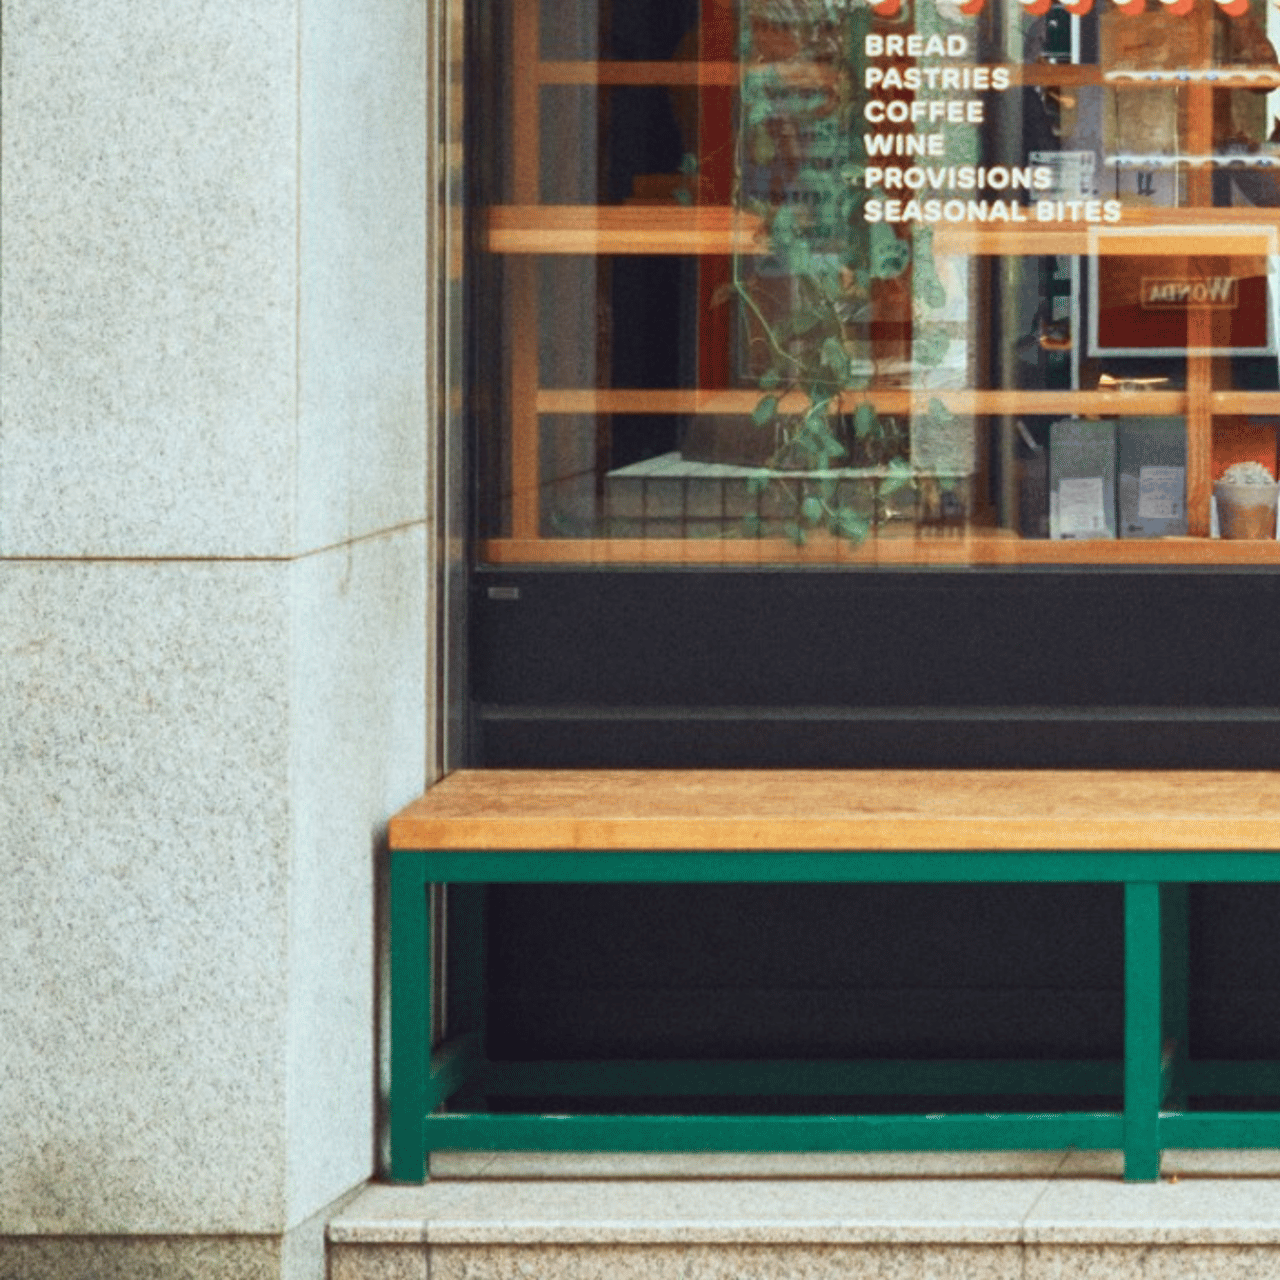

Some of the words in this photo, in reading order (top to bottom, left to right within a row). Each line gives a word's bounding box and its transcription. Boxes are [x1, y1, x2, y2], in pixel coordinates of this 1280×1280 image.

[865, 34, 967, 57] BREAD
[865, 67, 1010, 90] PASTRIES
[864, 100, 984, 124] COFFEE
[864, 133, 945, 156] WINE
[864, 166, 1052, 190] PROVISIONS
[864, 199, 1026, 223] SEASONAL
[1036, 199, 1122, 223] BITES
